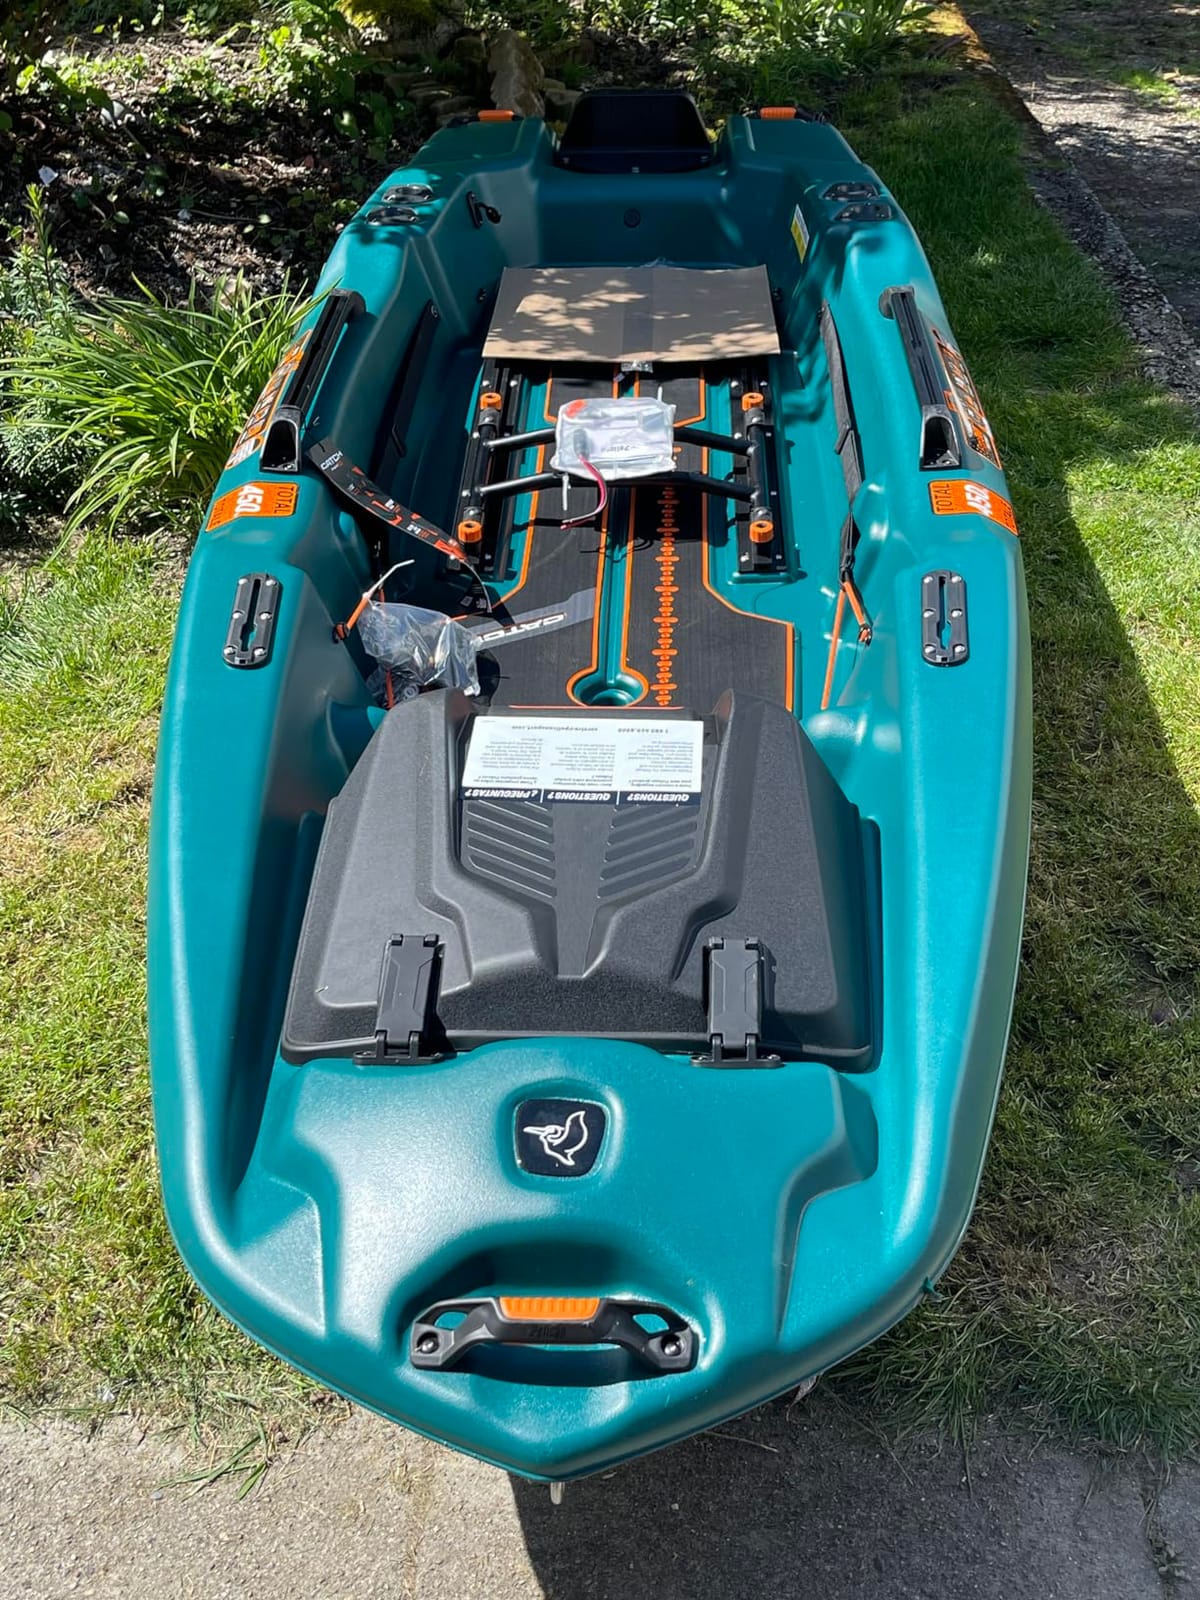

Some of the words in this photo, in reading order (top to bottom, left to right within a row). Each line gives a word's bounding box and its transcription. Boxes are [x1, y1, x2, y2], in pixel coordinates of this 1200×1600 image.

[320, 450, 344, 471] CATCH
[274, 486, 295, 514] TOTAL
[933, 483, 954, 512] TOTAL
[548, 791, 611, 801] QUESTIONS?
[627, 793, 690, 802] QUESTIONS?
